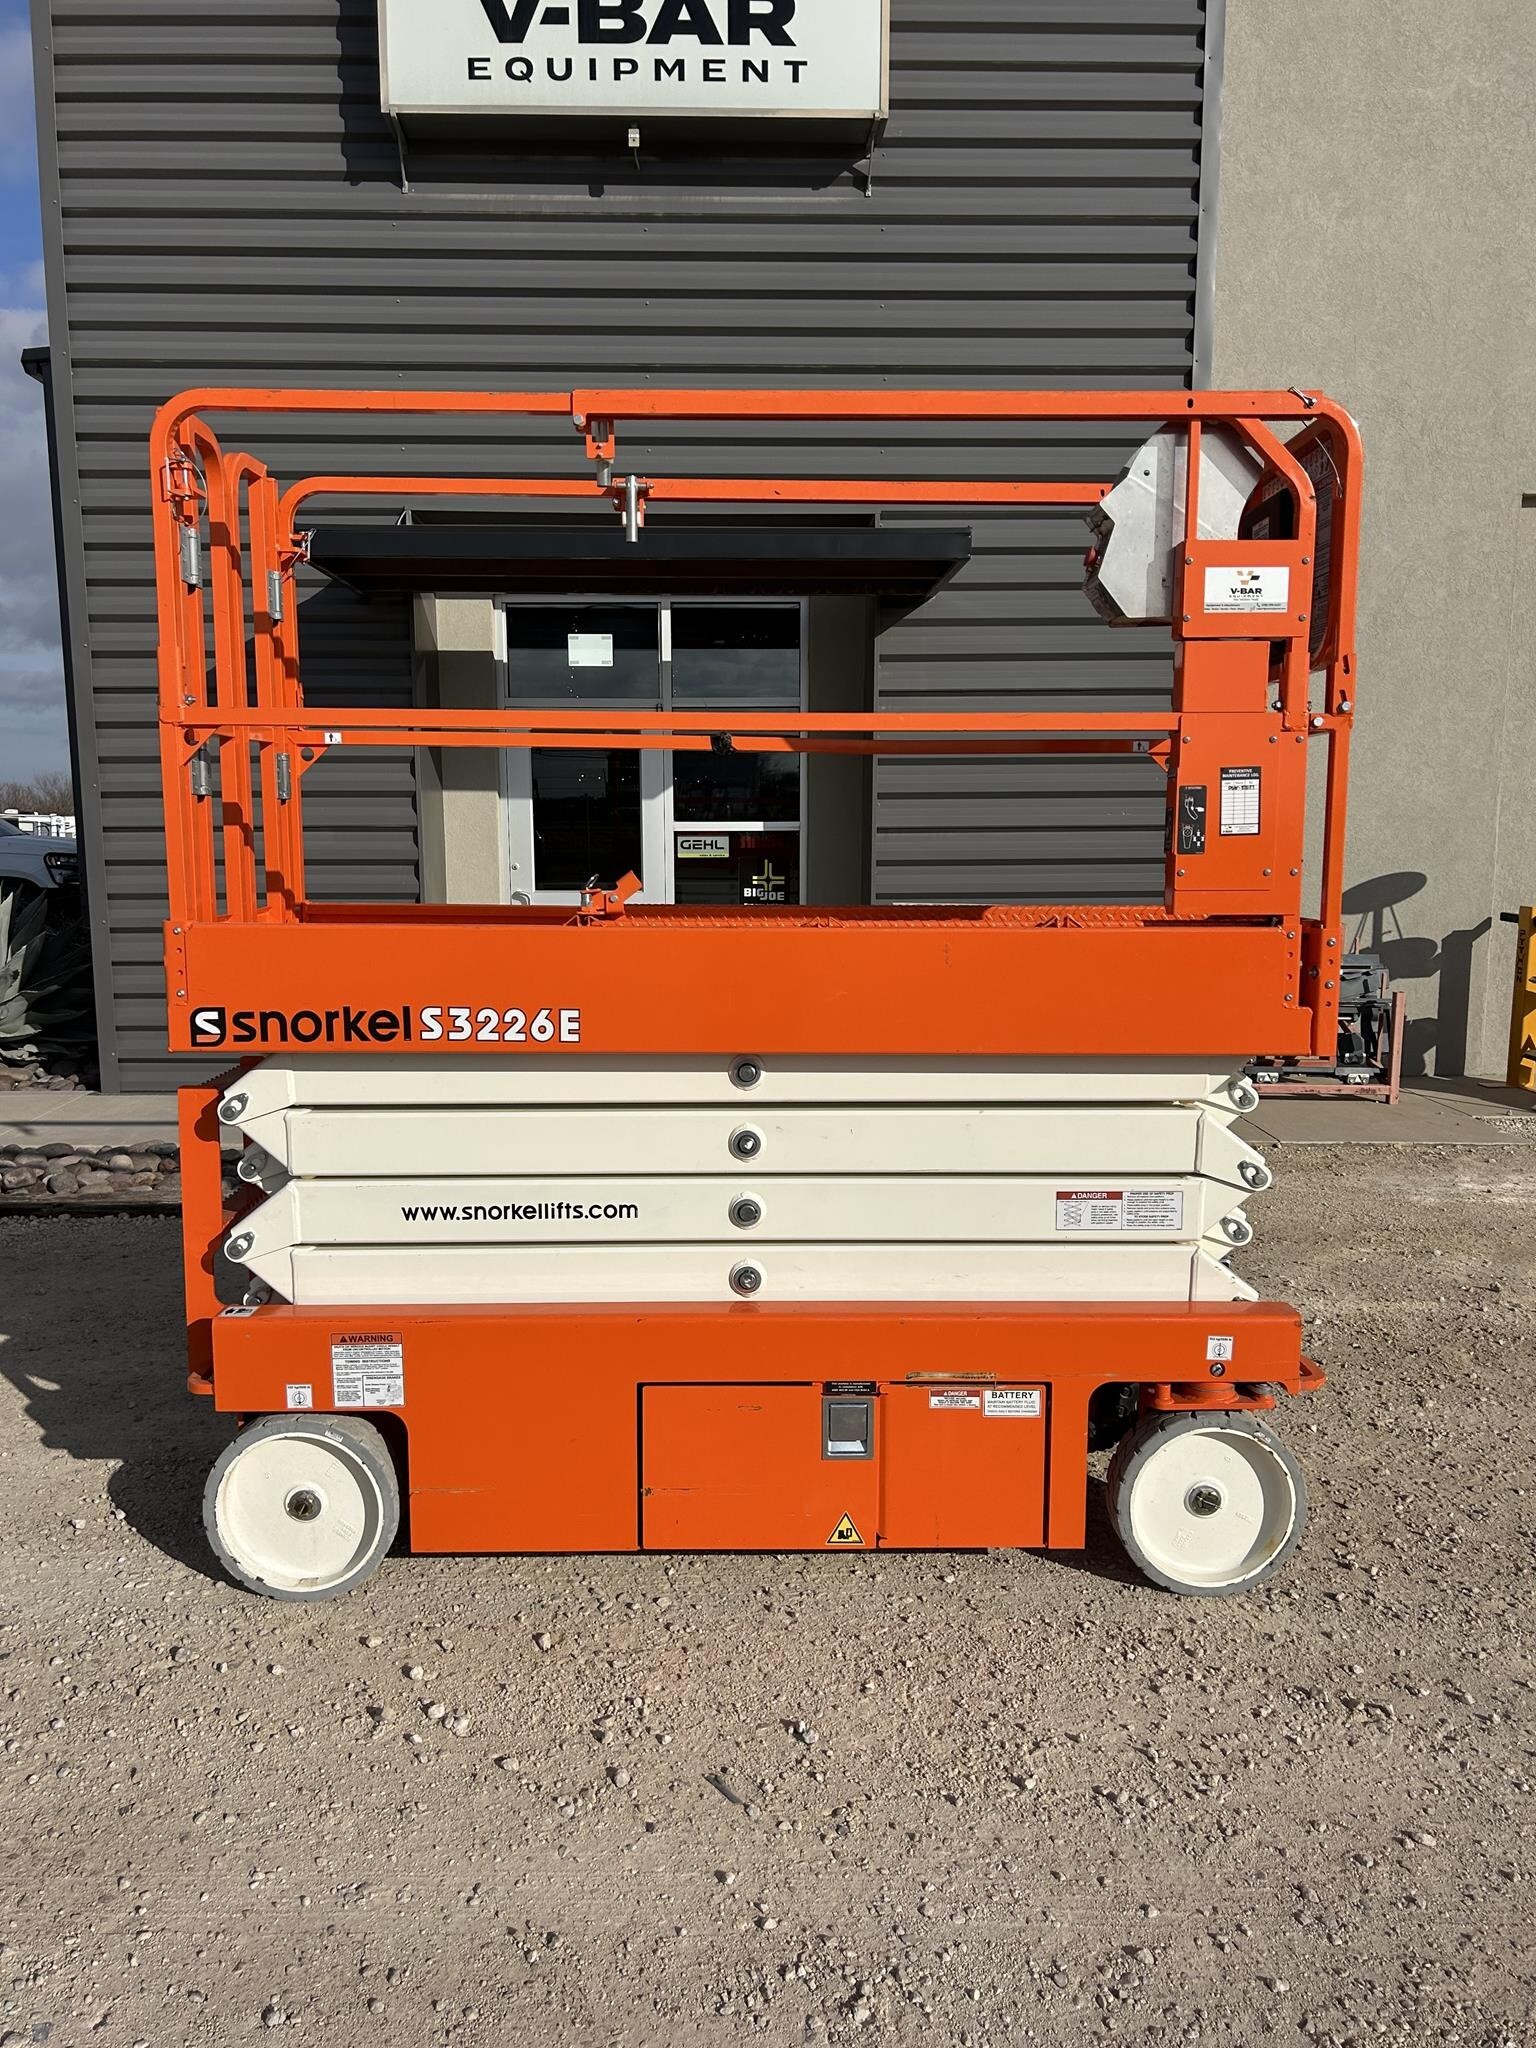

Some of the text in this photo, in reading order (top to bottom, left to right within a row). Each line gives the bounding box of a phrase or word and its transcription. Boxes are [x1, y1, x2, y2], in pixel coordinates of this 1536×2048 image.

[480, 0, 797, 46] V-BAR
[467, 56, 808, 83] EQUIPMENT
[680, 839, 725, 850] GEHL
[743, 887, 765, 897] BIG
[759, 891, 785, 901] JOE
[232, 1005, 412, 1043] snorkel
[420, 1005, 582, 1043] S3226E
[401, 1201, 639, 1221] www.snorkellifts.com
[348, 1334, 394, 1343] WARNING
[991, 1391, 1034, 1399] BATTERY
